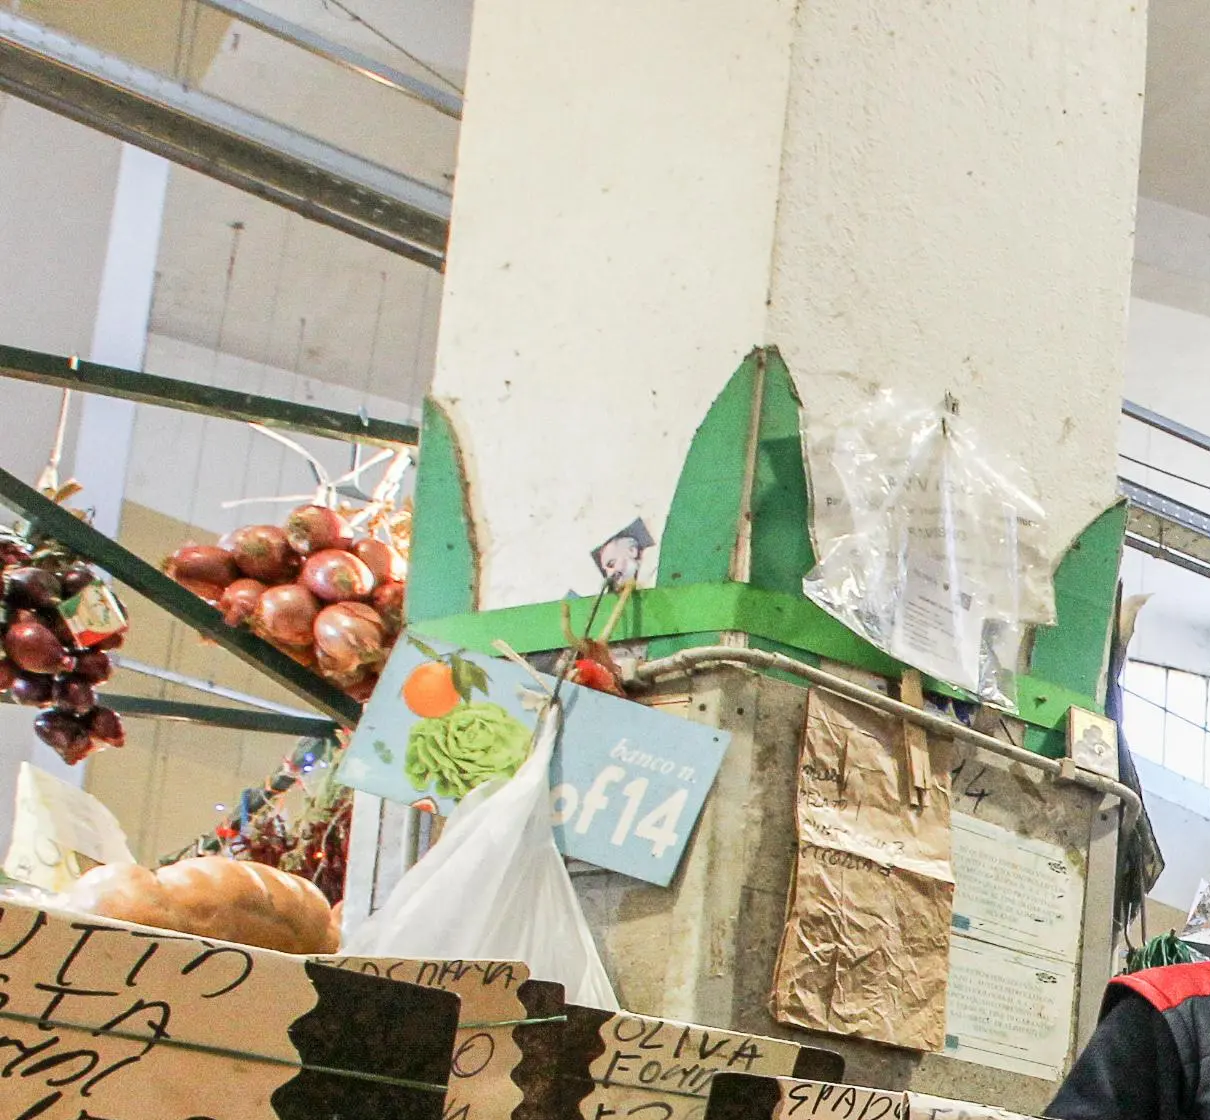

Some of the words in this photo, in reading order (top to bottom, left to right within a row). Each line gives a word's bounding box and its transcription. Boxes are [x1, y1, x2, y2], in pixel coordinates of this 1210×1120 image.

[609, 738, 675, 775] banco
[677, 765, 696, 784] n.
[612, 1013, 764, 1072] OLIVA
